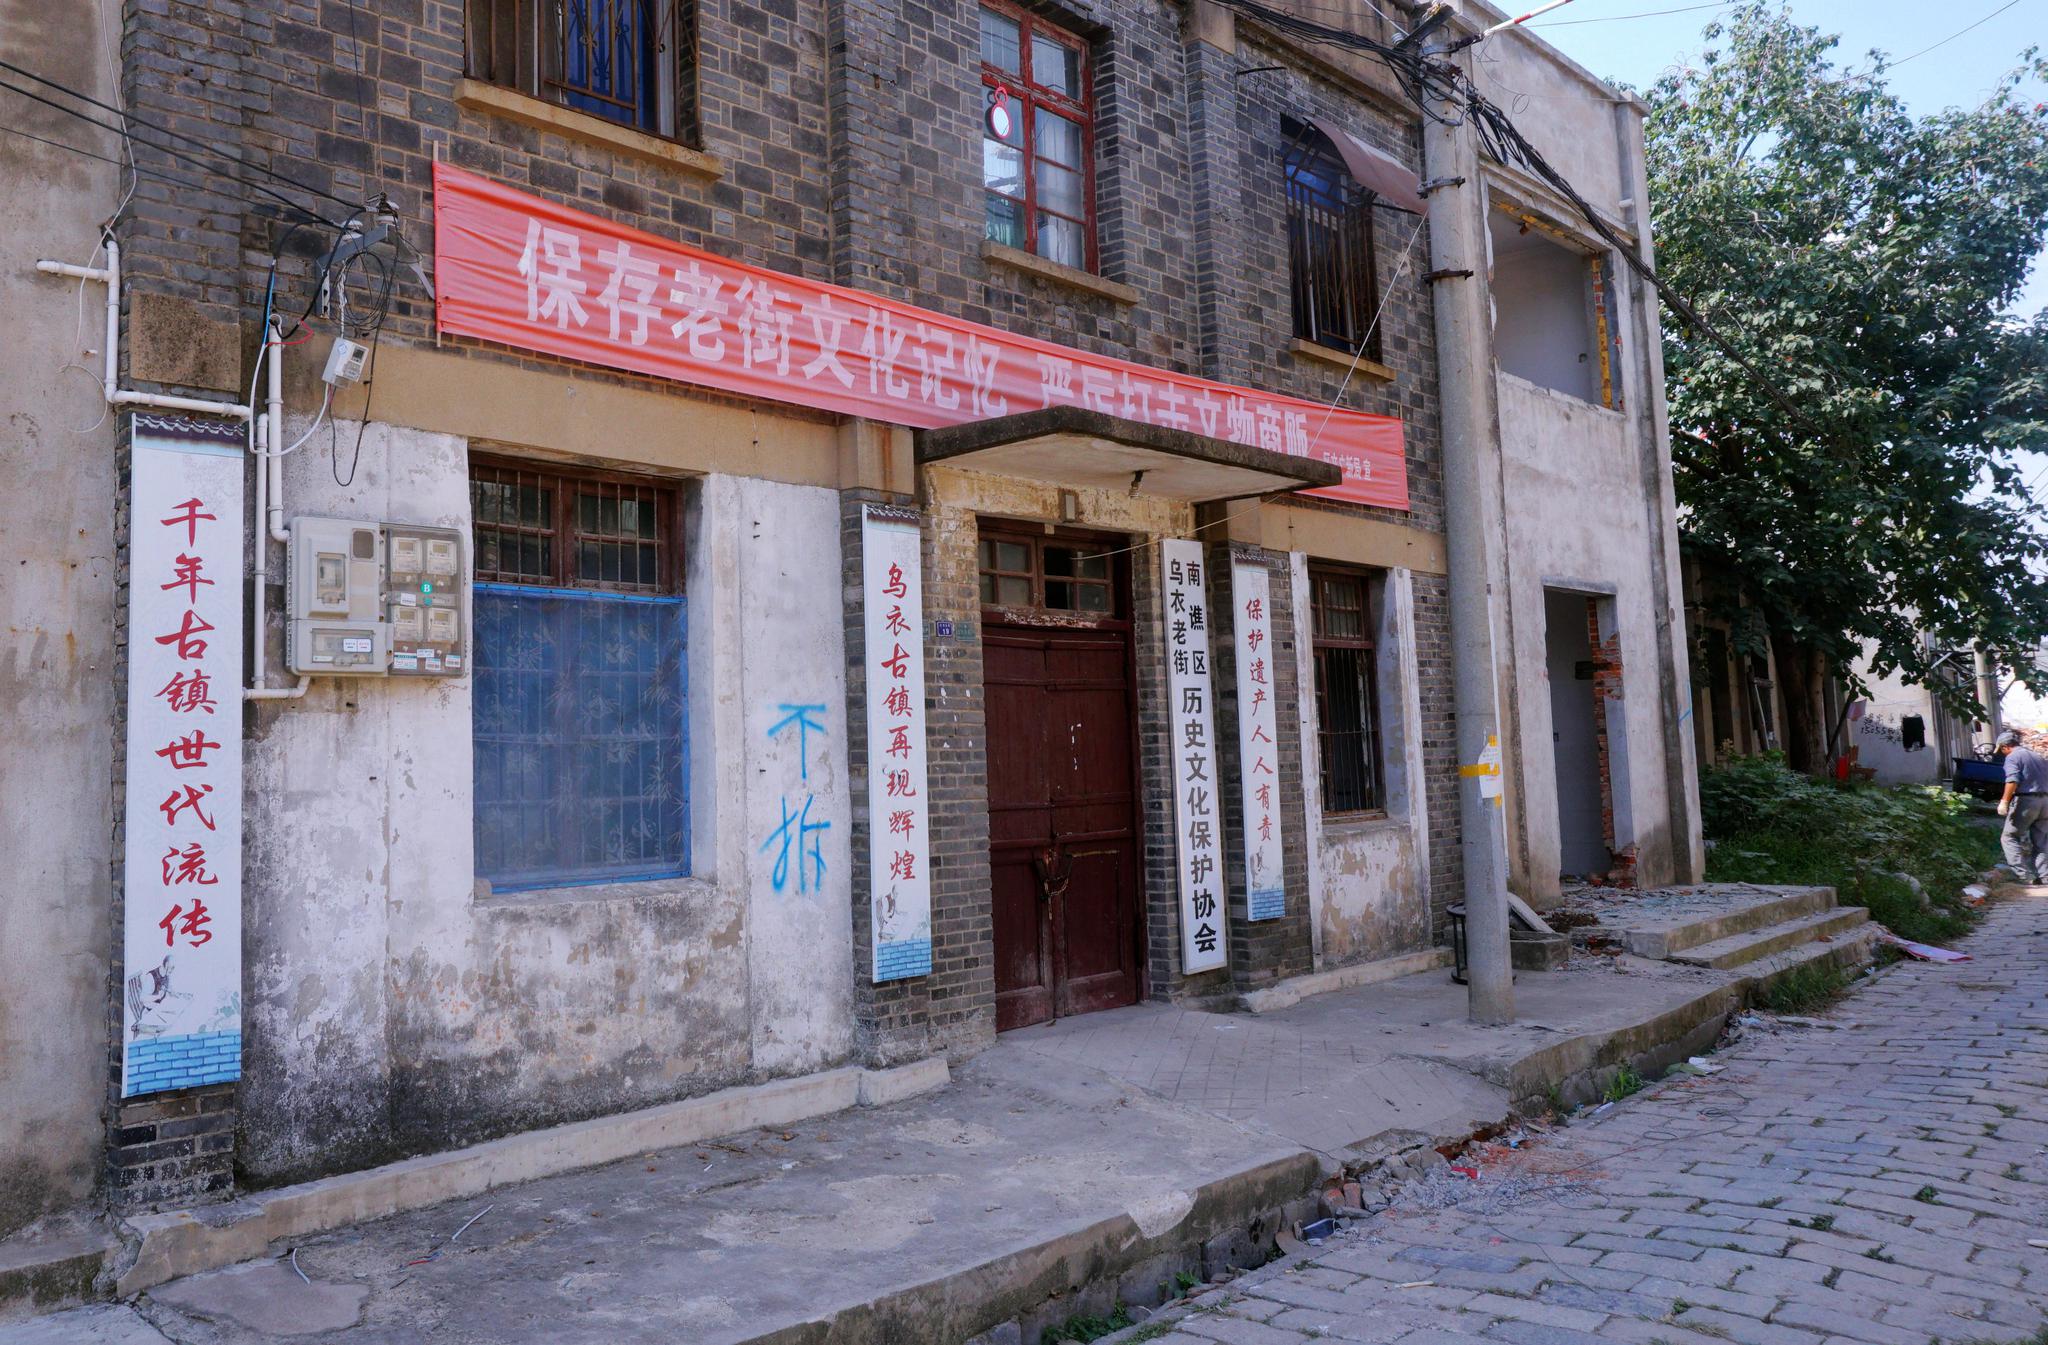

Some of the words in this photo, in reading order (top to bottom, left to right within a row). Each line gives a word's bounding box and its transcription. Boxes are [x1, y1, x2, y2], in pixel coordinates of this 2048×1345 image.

[517, 217, 1006, 417] 保存老街文化记忆
[155, 498, 221, 948] 千年古镇世代流传
[880, 561, 917, 881] 乌衣古镇再现辉煌
[1169, 558, 1189, 676] 乌衣老街
[1186, 560, 1207, 675] 南谯区
[1246, 598, 1273, 842] 保护遗产人人有责
[759, 703, 832, 894] 不拆
[1182, 687, 1217, 953] 历史文化保护协会
